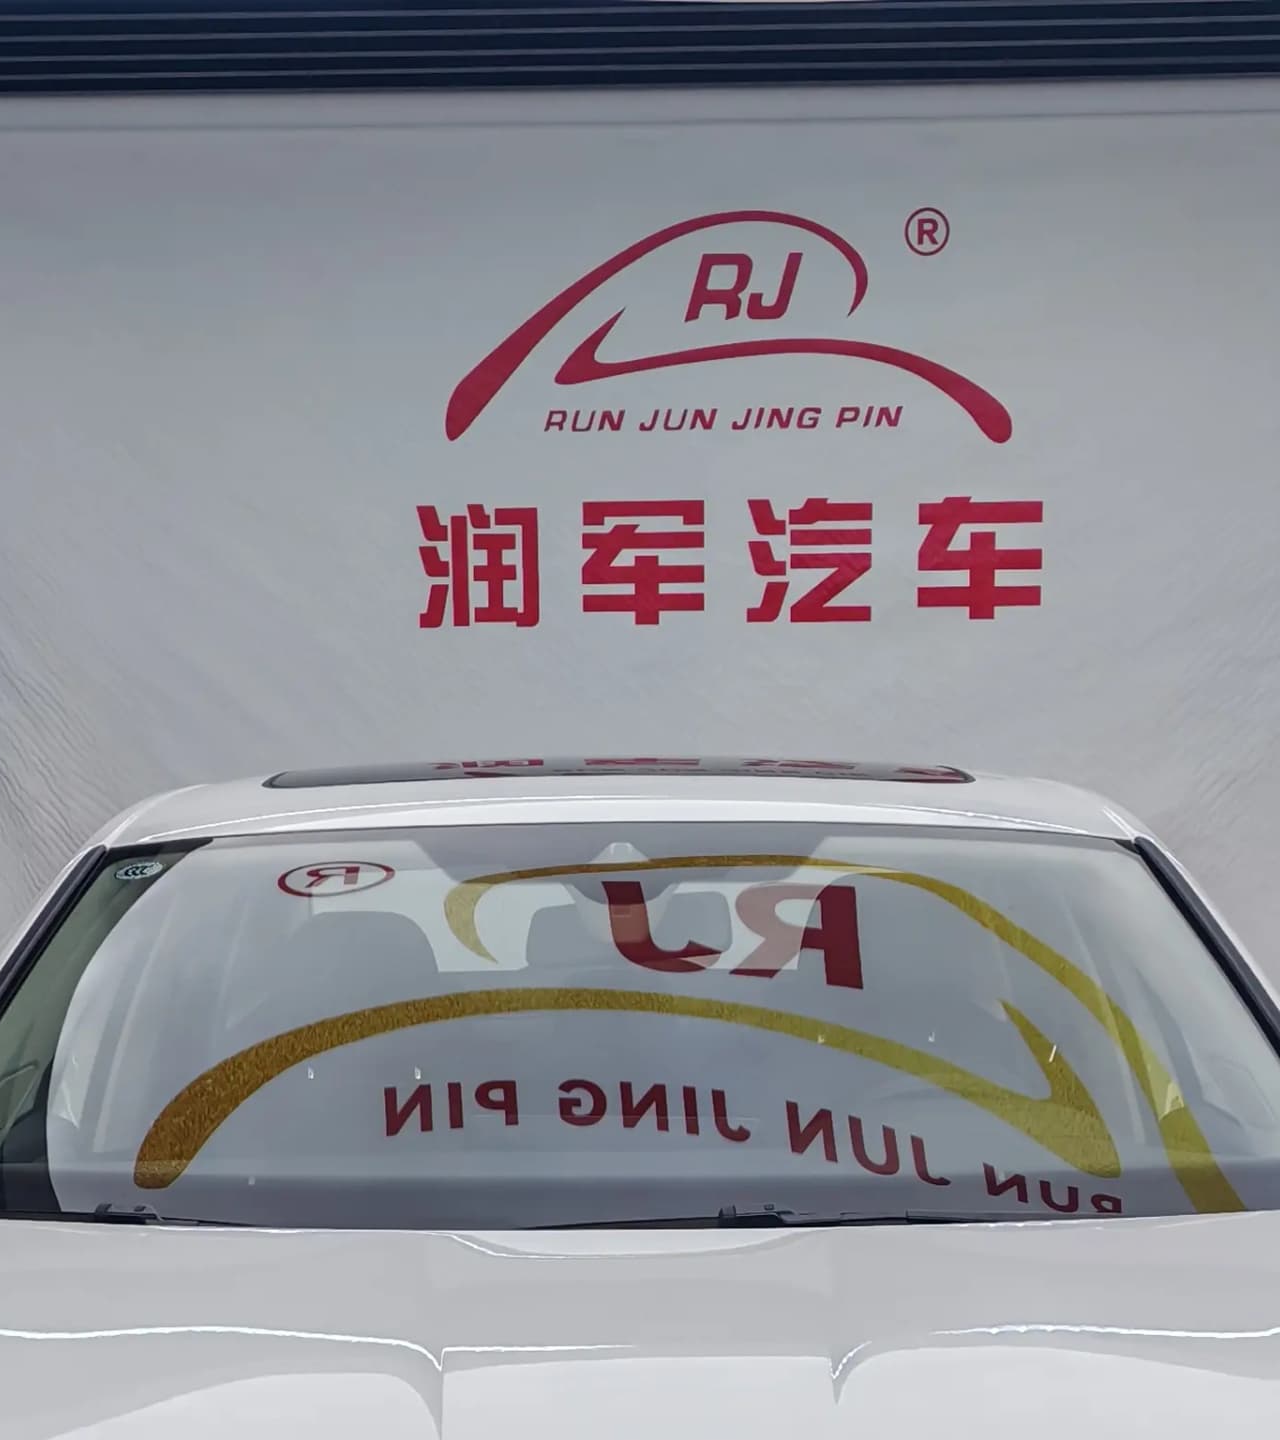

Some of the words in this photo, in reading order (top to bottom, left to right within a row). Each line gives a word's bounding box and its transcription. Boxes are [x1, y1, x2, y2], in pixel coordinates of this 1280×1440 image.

[683, 252, 803, 322] RJ
[544, 408, 627, 433] RUN
[638, 407, 718, 432] JUN
[731, 406, 822, 430] JING
[835, 405, 903, 429] PIN
[416, 496, 1044, 629] 润军汽车
